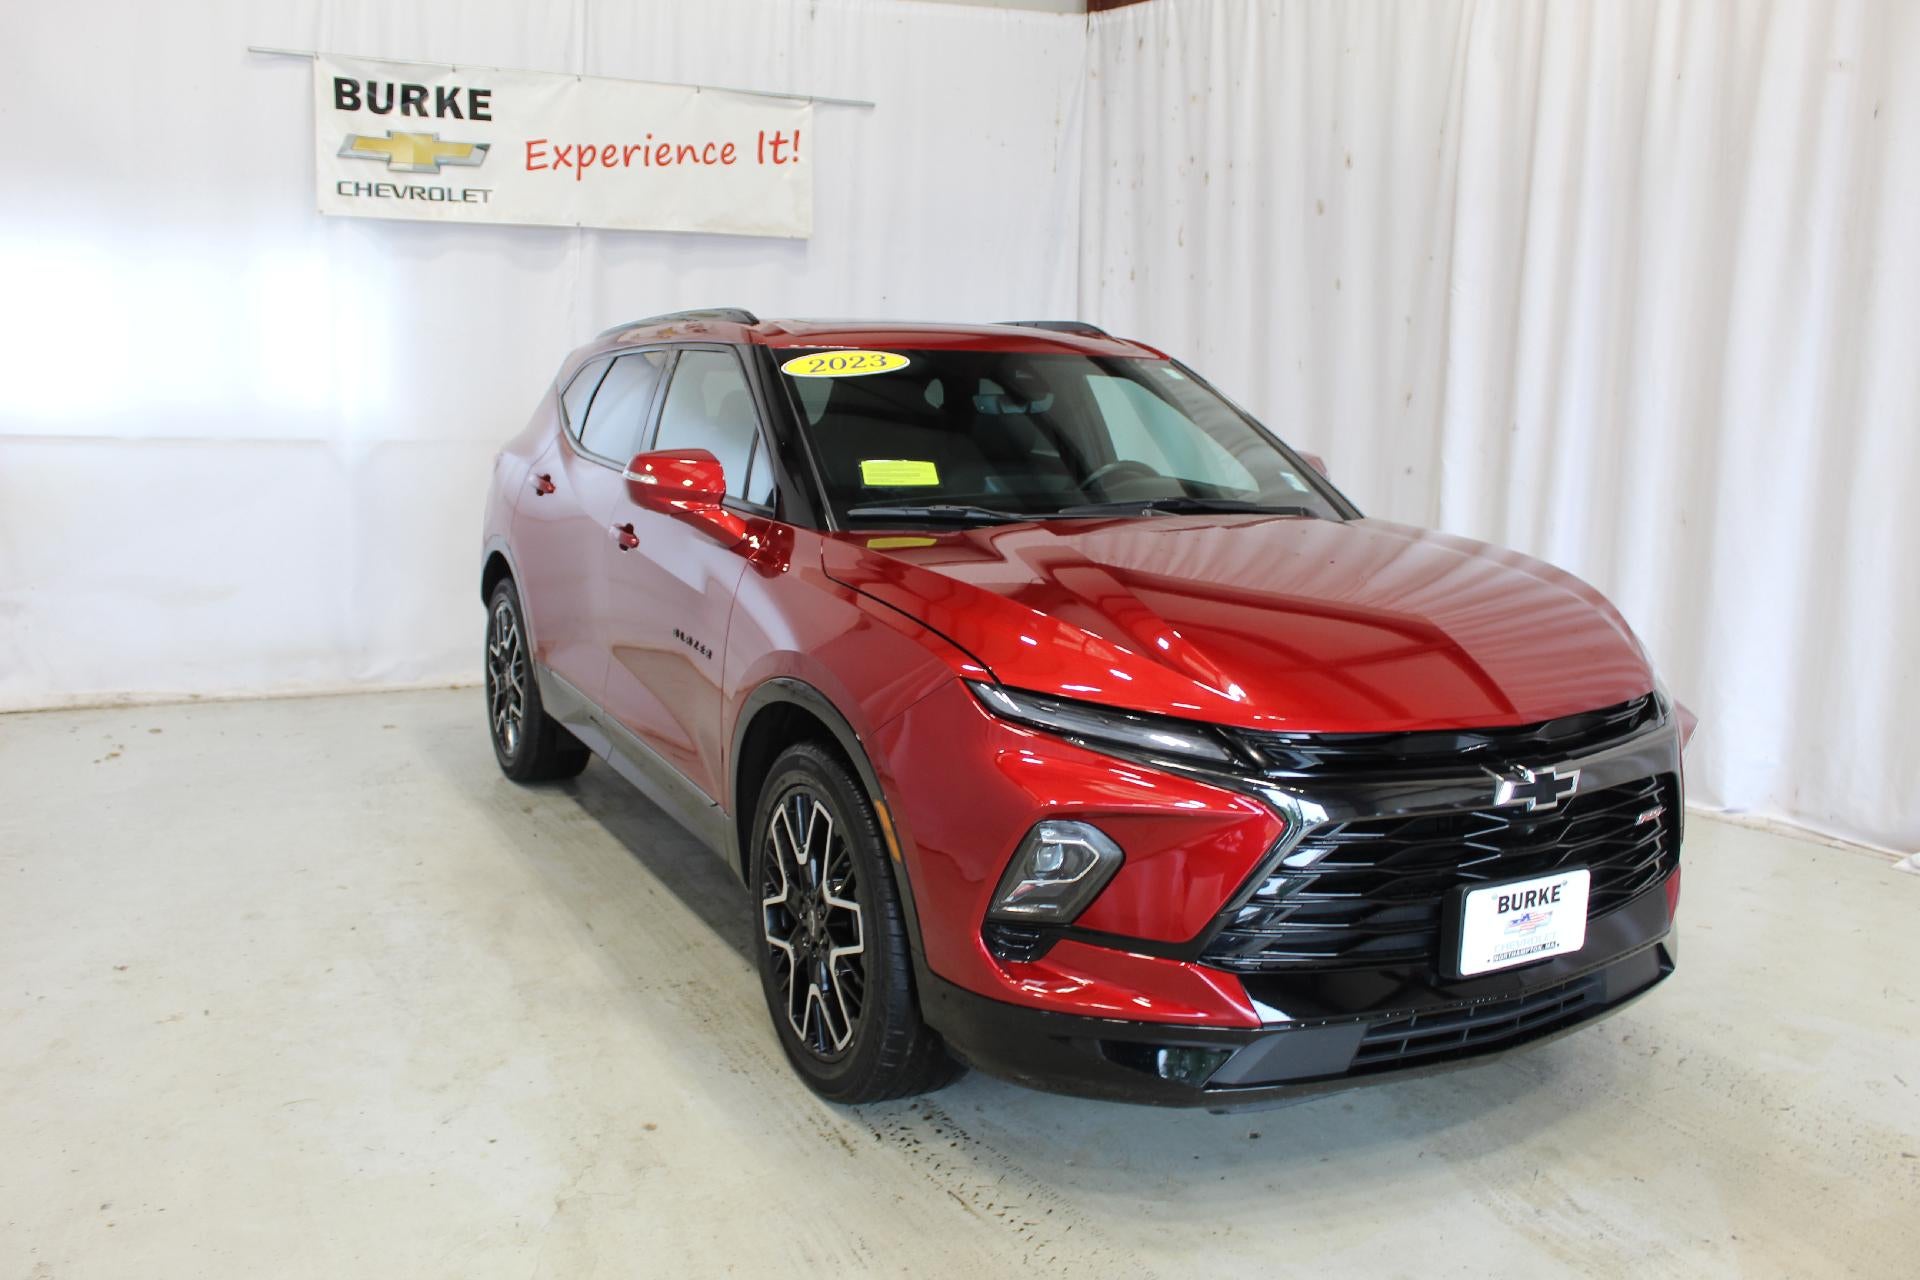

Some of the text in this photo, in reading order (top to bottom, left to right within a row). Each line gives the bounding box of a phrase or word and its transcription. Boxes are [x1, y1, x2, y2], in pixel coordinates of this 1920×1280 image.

[333, 76, 493, 122] BURKE
[525, 129, 801, 181] Experience It!
[336, 180, 493, 203] CHEVROLET
[809, 354, 888, 373] 2023
[1497, 883, 1562, 914] BURKE
